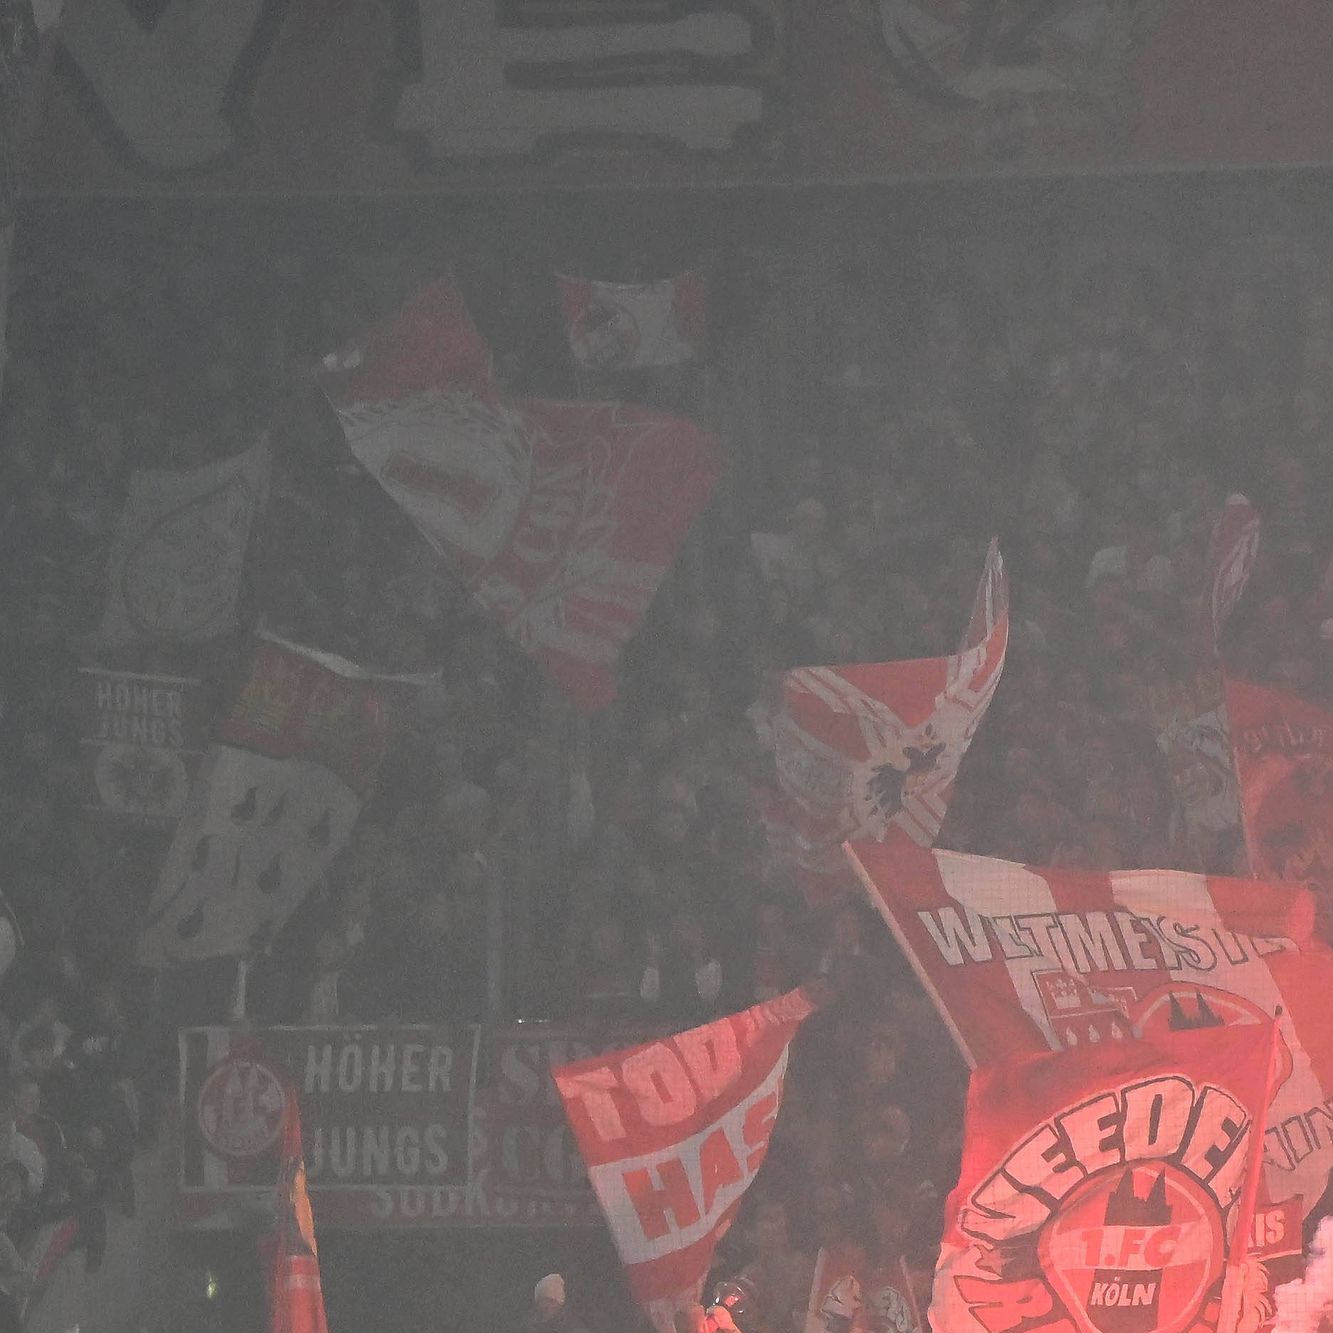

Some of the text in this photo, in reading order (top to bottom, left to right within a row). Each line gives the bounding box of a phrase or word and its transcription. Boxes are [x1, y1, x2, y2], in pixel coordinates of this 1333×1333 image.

[305, 1033, 453, 1094] HÖHER
[306, 1123, 449, 1179] JUNGS
[1089, 1277, 1157, 1307] KÖLN
